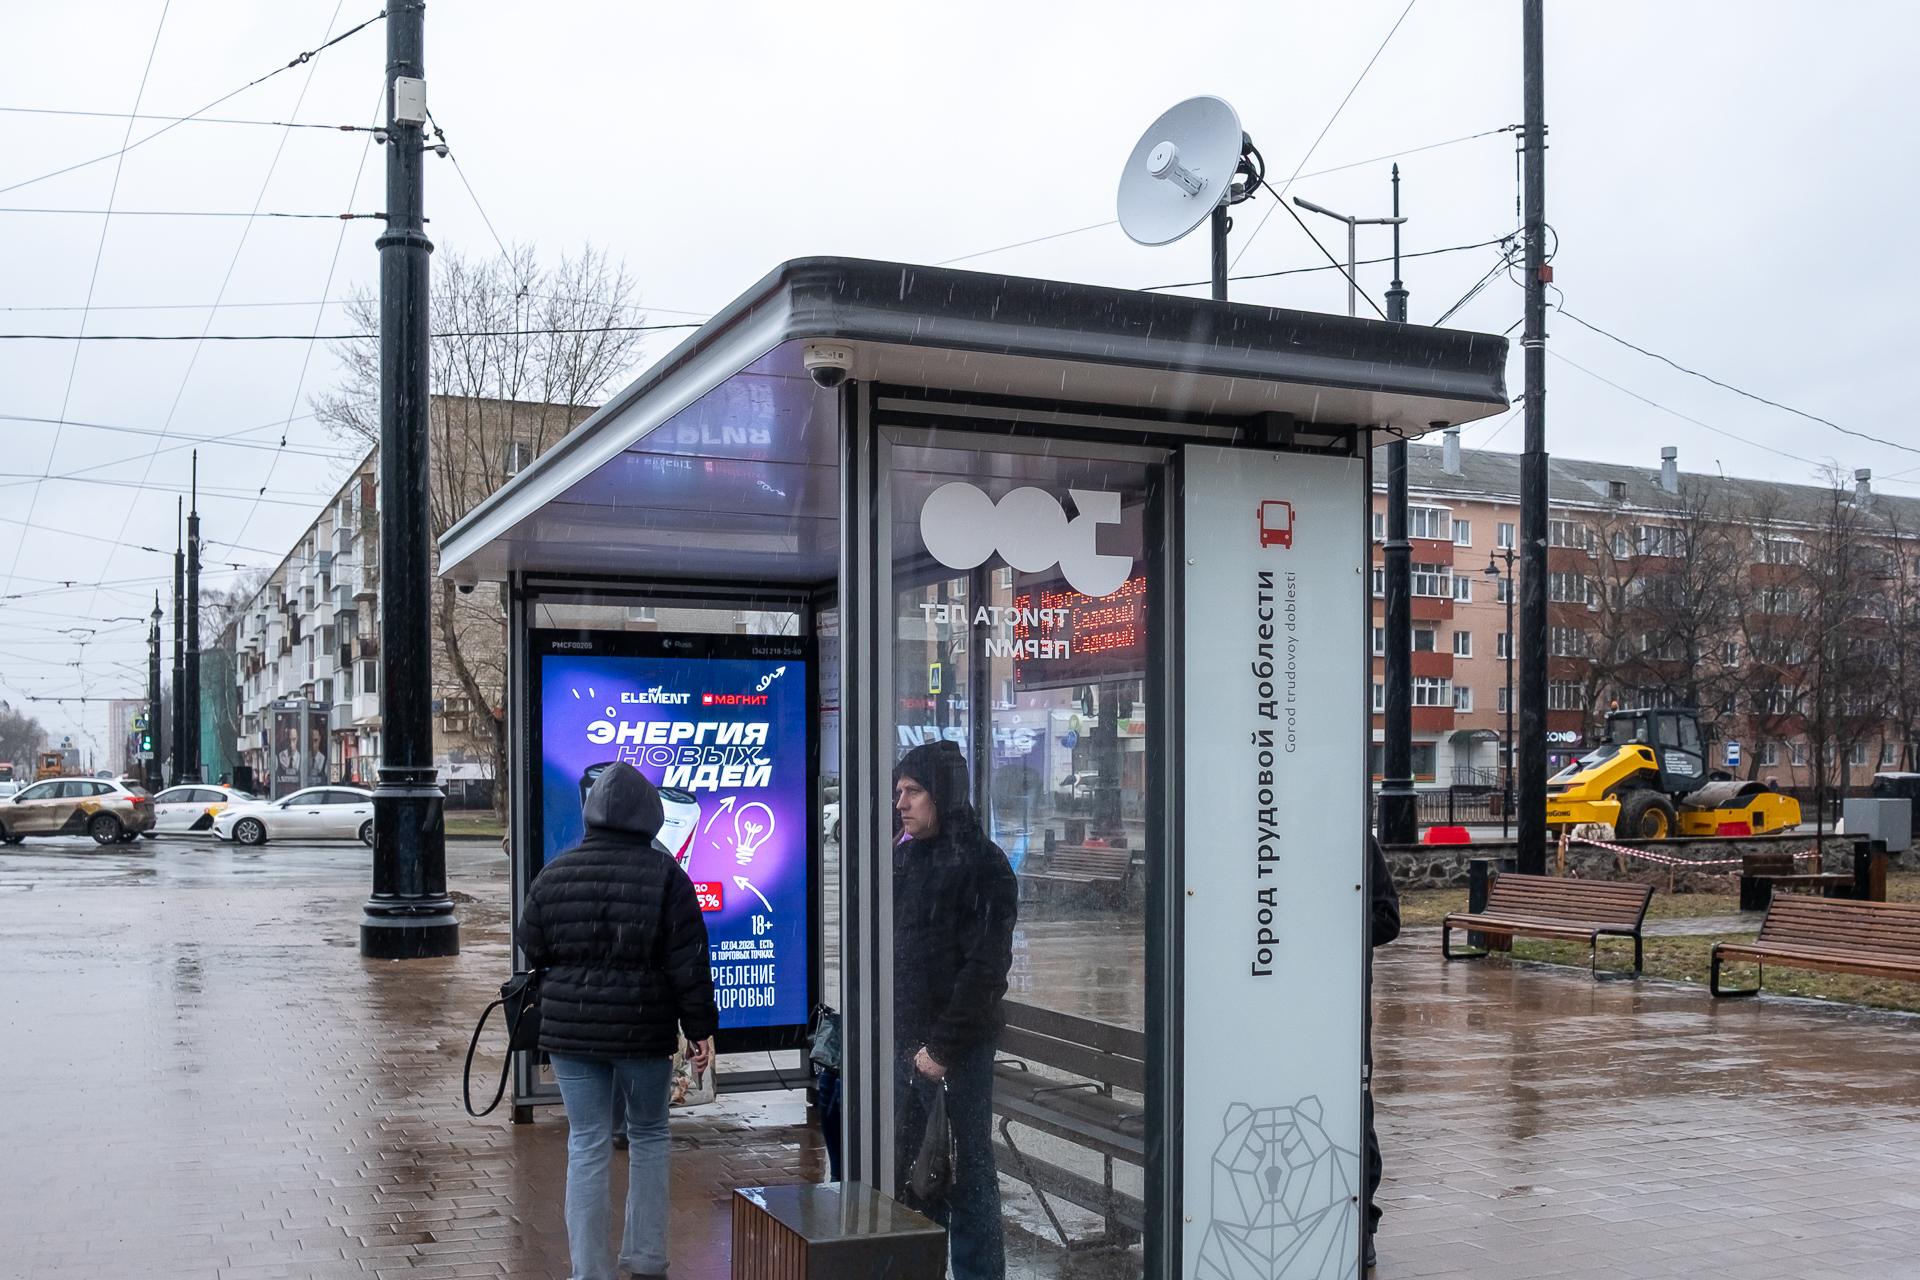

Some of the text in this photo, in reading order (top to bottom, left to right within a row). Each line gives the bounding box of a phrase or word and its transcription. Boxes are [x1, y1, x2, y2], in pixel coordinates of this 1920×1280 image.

[1285, 571, 1299, 753] Gorod trudovoy doblesti
[621, 685, 690, 704] ELEMENT
[586, 721, 770, 745] ЭНЕРГИЯ
[616, 746, 763, 767] НОВЫХ
[662, 757, 773, 792] ИДЕЙ
[1251, 571, 1281, 976] Город трудовой доблести
[697, 894, 720, 908] 5%
[751, 915, 774, 935] 18+
[759, 939, 774, 949] ЕСТЬ
[711, 964, 776, 986] РЕБЛЕНИЕ
[714, 986, 775, 1012] ДОРОВЬЮ
